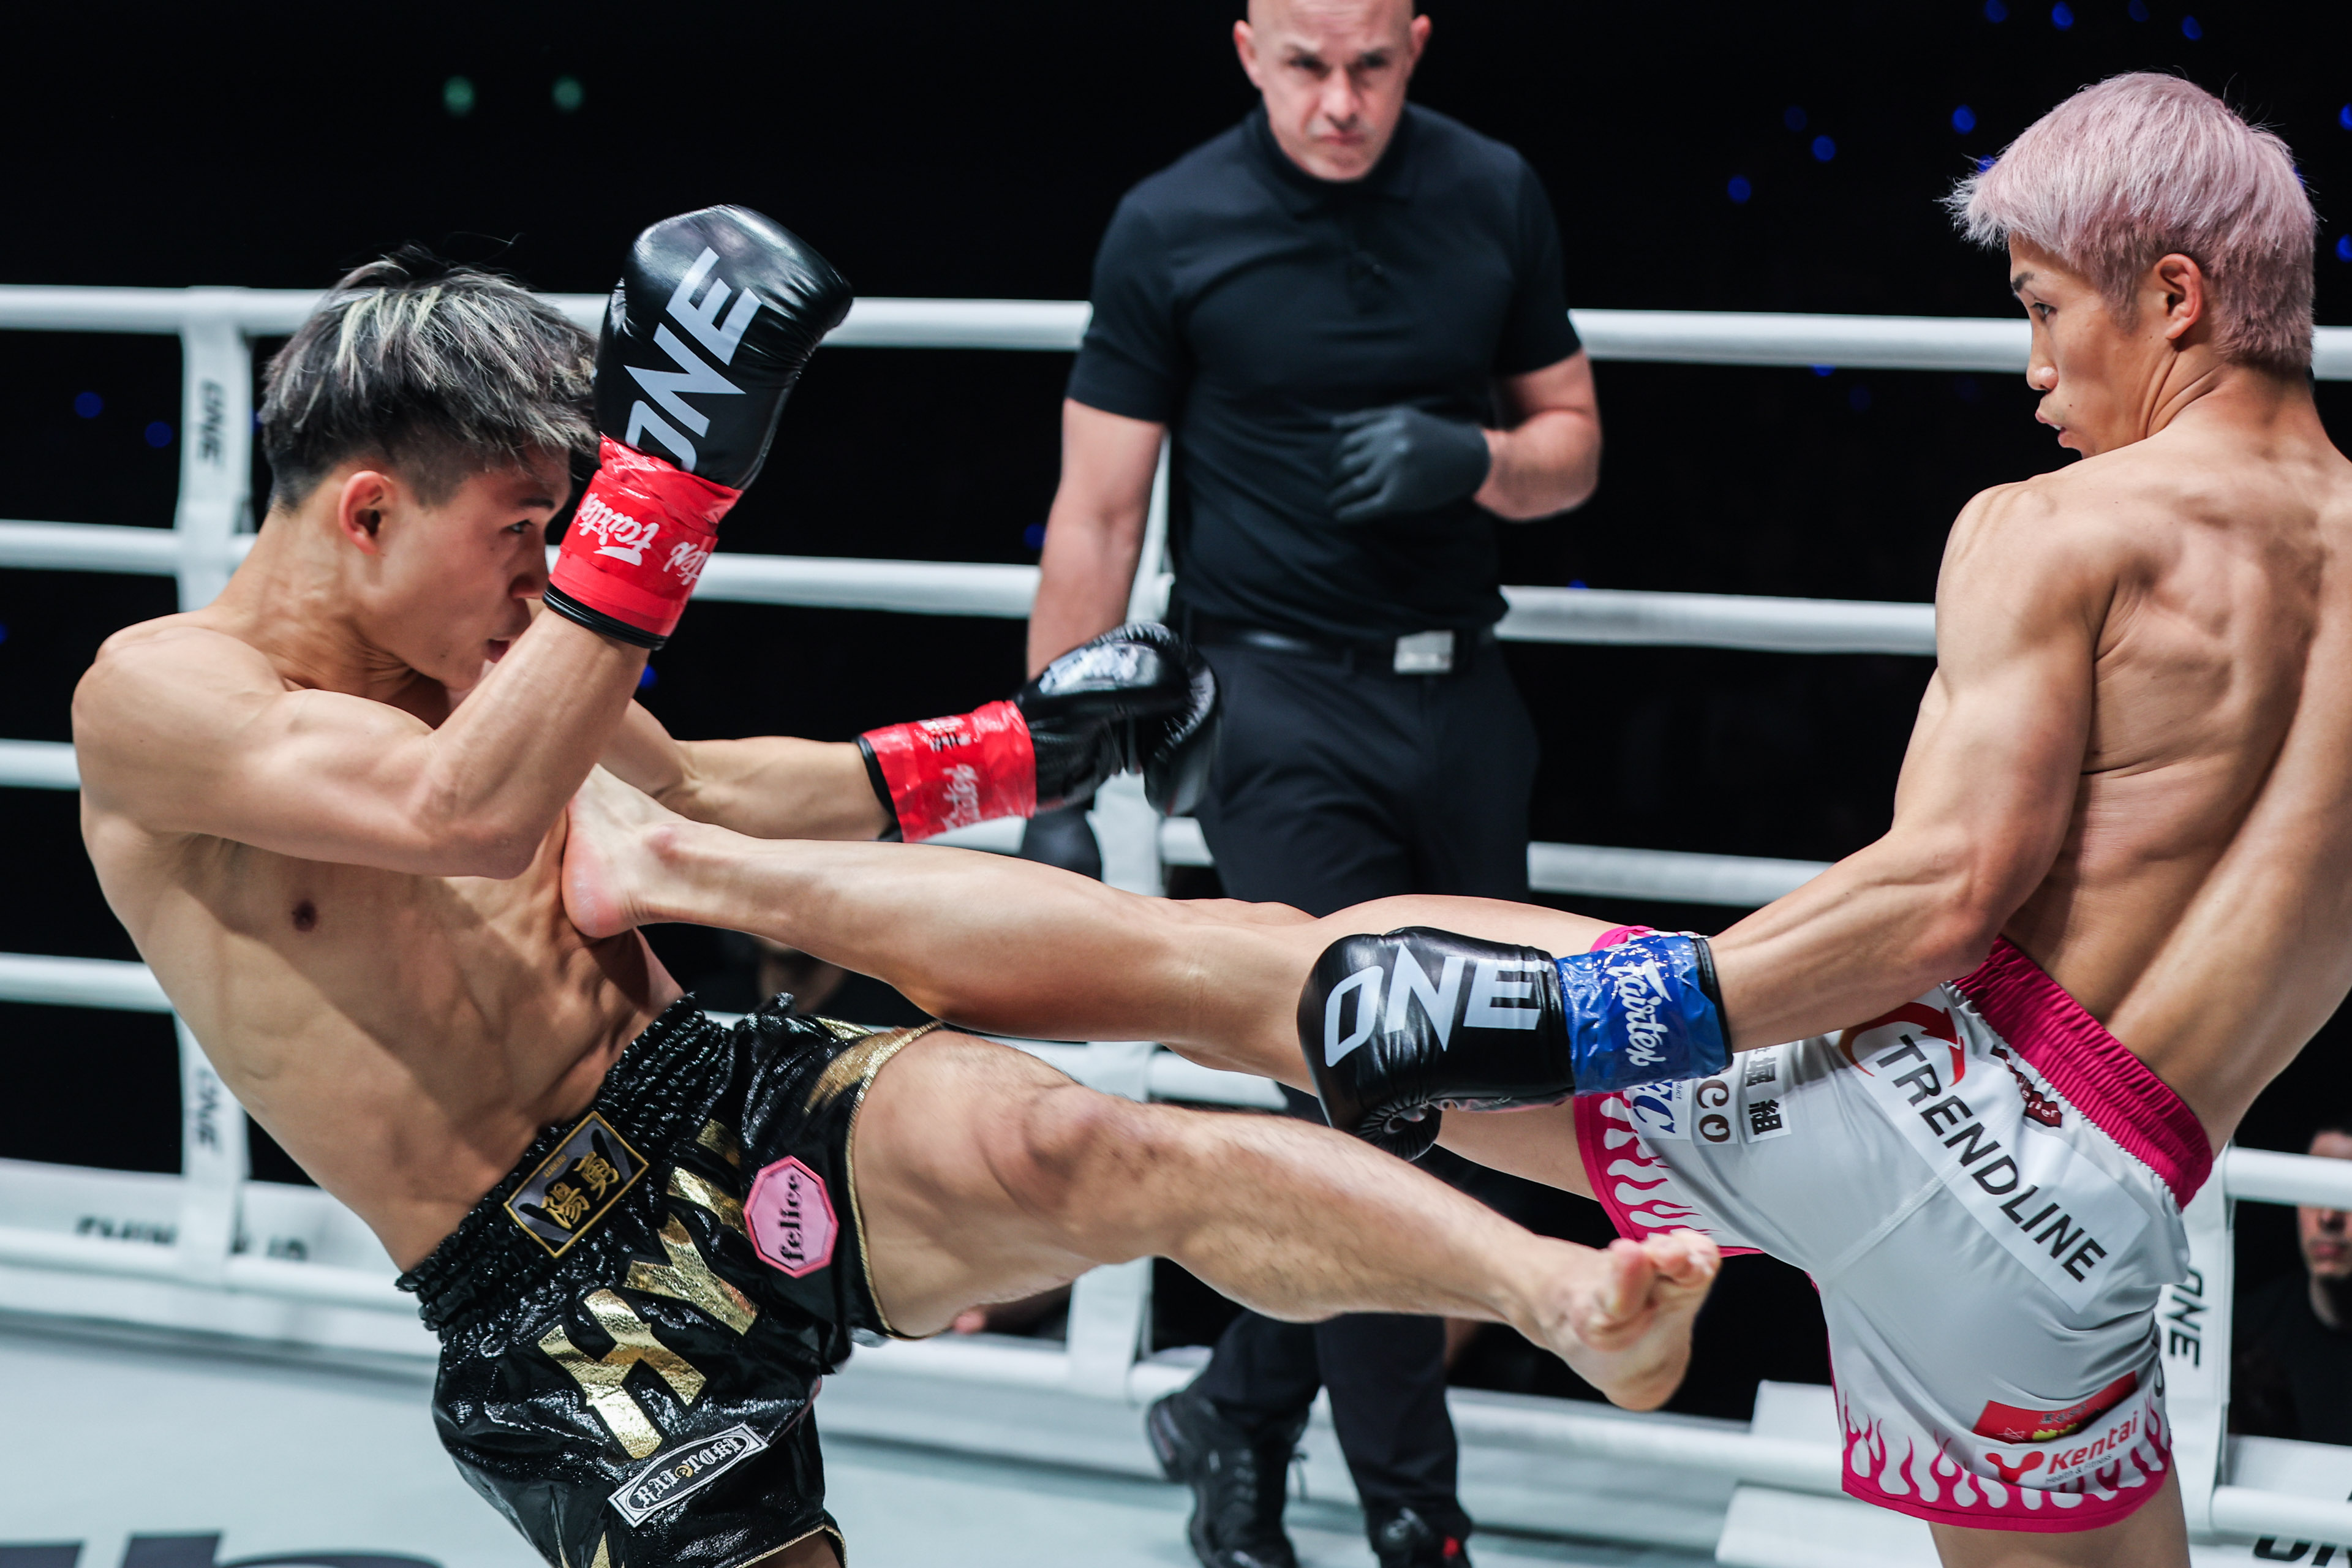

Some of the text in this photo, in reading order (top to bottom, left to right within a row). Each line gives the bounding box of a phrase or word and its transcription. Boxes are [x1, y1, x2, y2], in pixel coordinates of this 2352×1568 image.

[624, 247, 763, 472] ONE
[1324, 942, 1548, 1068] ONE
[1606, 959, 1672, 1067] Fairtex
[541, 1151, 620, 1231] 陽勇
[1875, 1034, 2107, 1283] TRENDLINE
[778, 1172, 804, 1264] felice
[2165, 1268, 2208, 1368] ONE
[2047, 1410, 2138, 1474] Kentai
